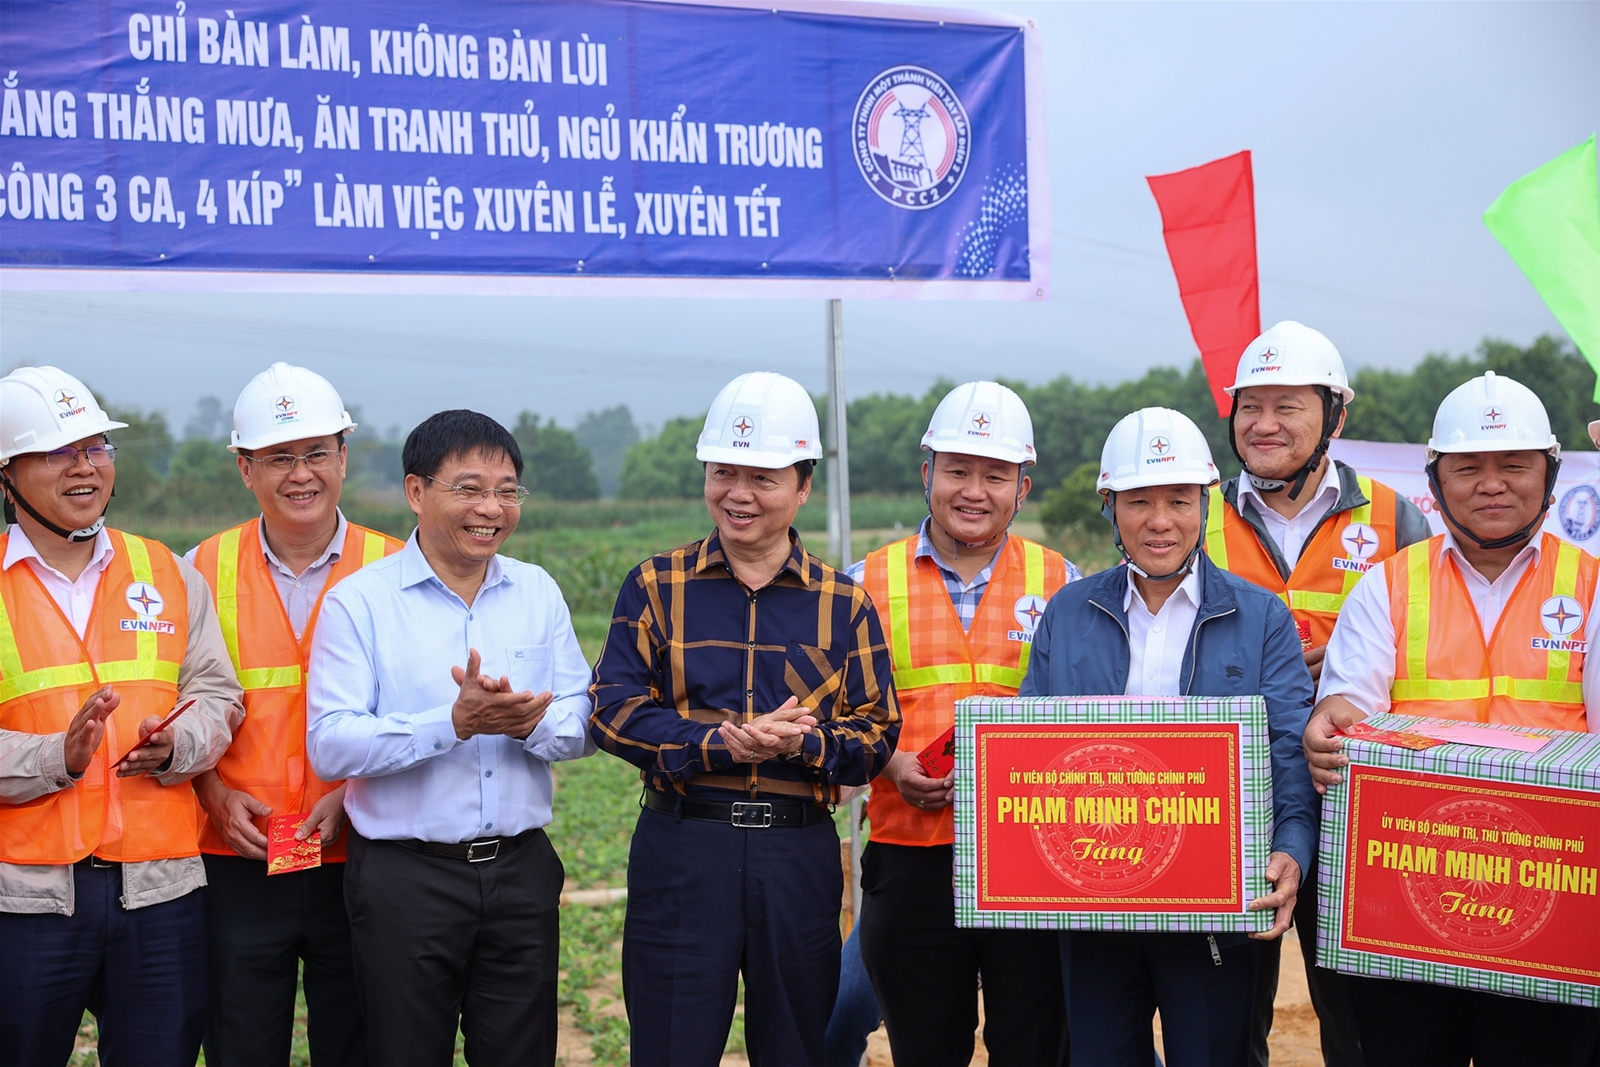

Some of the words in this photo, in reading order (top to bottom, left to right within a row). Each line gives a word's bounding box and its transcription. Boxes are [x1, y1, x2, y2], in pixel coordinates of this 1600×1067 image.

[128, 0, 187, 62] CHỈ
[198, 10, 269, 67] BÀN
[279, 15, 360, 79] LÀM,
[371, 23, 479, 80] KHÔNG
[488, 29, 552, 83] BÀN
[561, 33, 608, 86] LÙI
[87, 77, 205, 145] THẮNG
[216, 97, 304, 154] MƯA,
[314, 94, 360, 151] ĂN
[369, 106, 474, 155] TRANH
[481, 99, 550, 163] THỦ,
[558, 103, 621, 161] NGỦ
[629, 104, 708, 164] KHẨN
[714, 121, 823, 169] TRƯƠNG
[857, 123, 867, 139] TY
[95, 174, 117, 222] 3
[128, 175, 186, 230] CA,
[196, 179, 218, 224] 4
[313, 173, 385, 229] LÀM
[393, 176, 465, 240] VIỆC
[473, 180, 575, 232] XUYÊN
[582, 175, 627, 240] LỄ,
[634, 186, 727, 237] XUYÊN
[734, 183, 781, 238] TẾT
[1251, 365, 1282, 374] EVNNPT
[59, 406, 86, 419] EVNNPT
[732, 440, 750, 448] EVN
[1146, 456, 1176, 464] EVNNPT
[121, 620, 174, 632] EVNNPT
[1531, 638, 1588, 652] EVNNPT
[1009, 766, 1021, 784] ỦY
[1023, 769, 1043, 784] VIÊN
[1045, 769, 1057, 787] BỘ
[1060, 769, 1086, 784] CHÍNH
[1088, 771, 1105, 786] TRỊ,
[1107, 767, 1124, 784] THỦ
[1157, 769, 1185, 784] CHÍNH
[1187, 766, 1205, 784] PHỦ
[997, 796, 1066, 830] PHẠM
[1074, 797, 1138, 824] MINH
[1146, 791, 1220, 825] CHÍNH
[1381, 811, 1393, 829] ỦY
[1395, 816, 1416, 833] VIÊN
[1418, 819, 1430, 837] BỘ
[1432, 821, 1460, 838] CHÍNH
[1462, 826, 1479, 843] TRỊ,
[1481, 825, 1499, 843] THỦ
[1533, 834, 1563, 851] CHÍNH
[1564, 835, 1584, 853] PHỦ
[1071, 838, 1146, 866] Tặng
[1366, 839, 1437, 878] PHẠM
[1444, 849, 1512, 886] MINH
[1519, 857, 1598, 896] CHÍNH
[1439, 891, 1515, 926] Tặng
